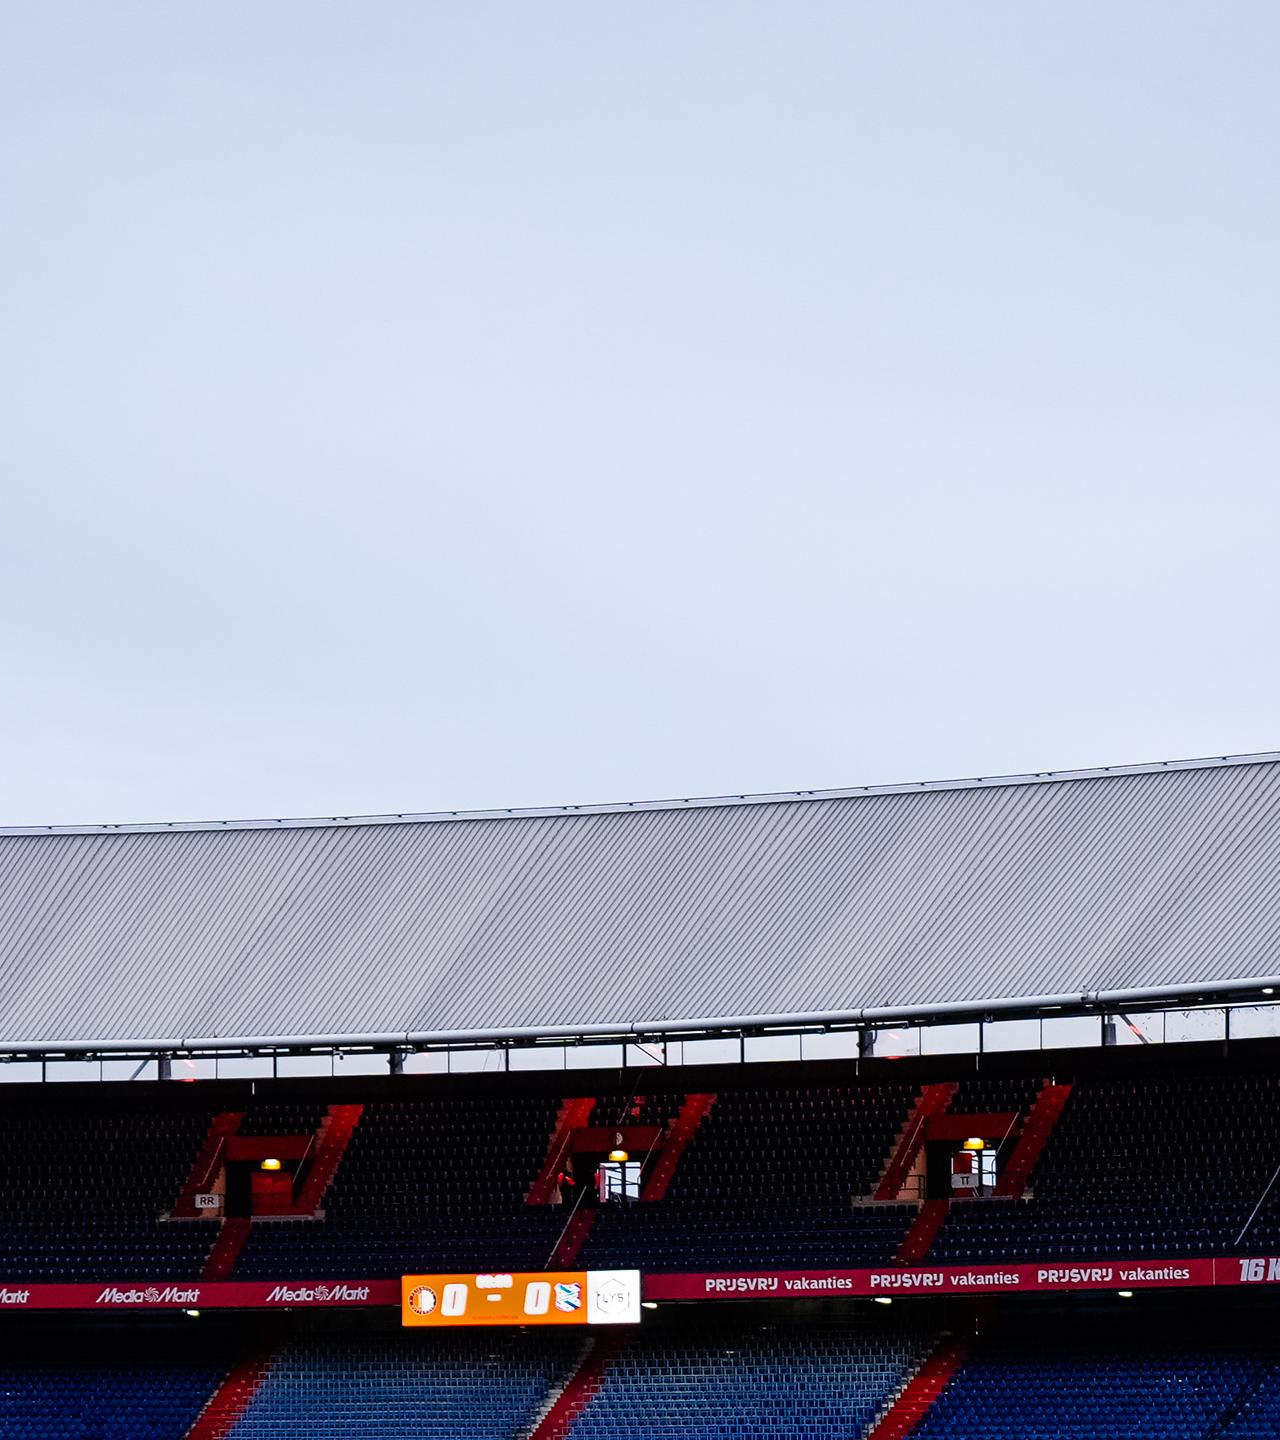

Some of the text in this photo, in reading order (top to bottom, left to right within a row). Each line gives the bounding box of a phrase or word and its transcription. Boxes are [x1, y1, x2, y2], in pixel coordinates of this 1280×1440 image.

[199, 1196, 215, 1206] RR
[1119, 1266, 1190, 1282] vakanties
[1238, 1258, 1264, 1282] 16
[784, 1275, 853, 1291] vakanties
[950, 1271, 1020, 1287] vakanties
[441, 1283, 468, 1316] 0
[524, 1282, 551, 1315] 0
